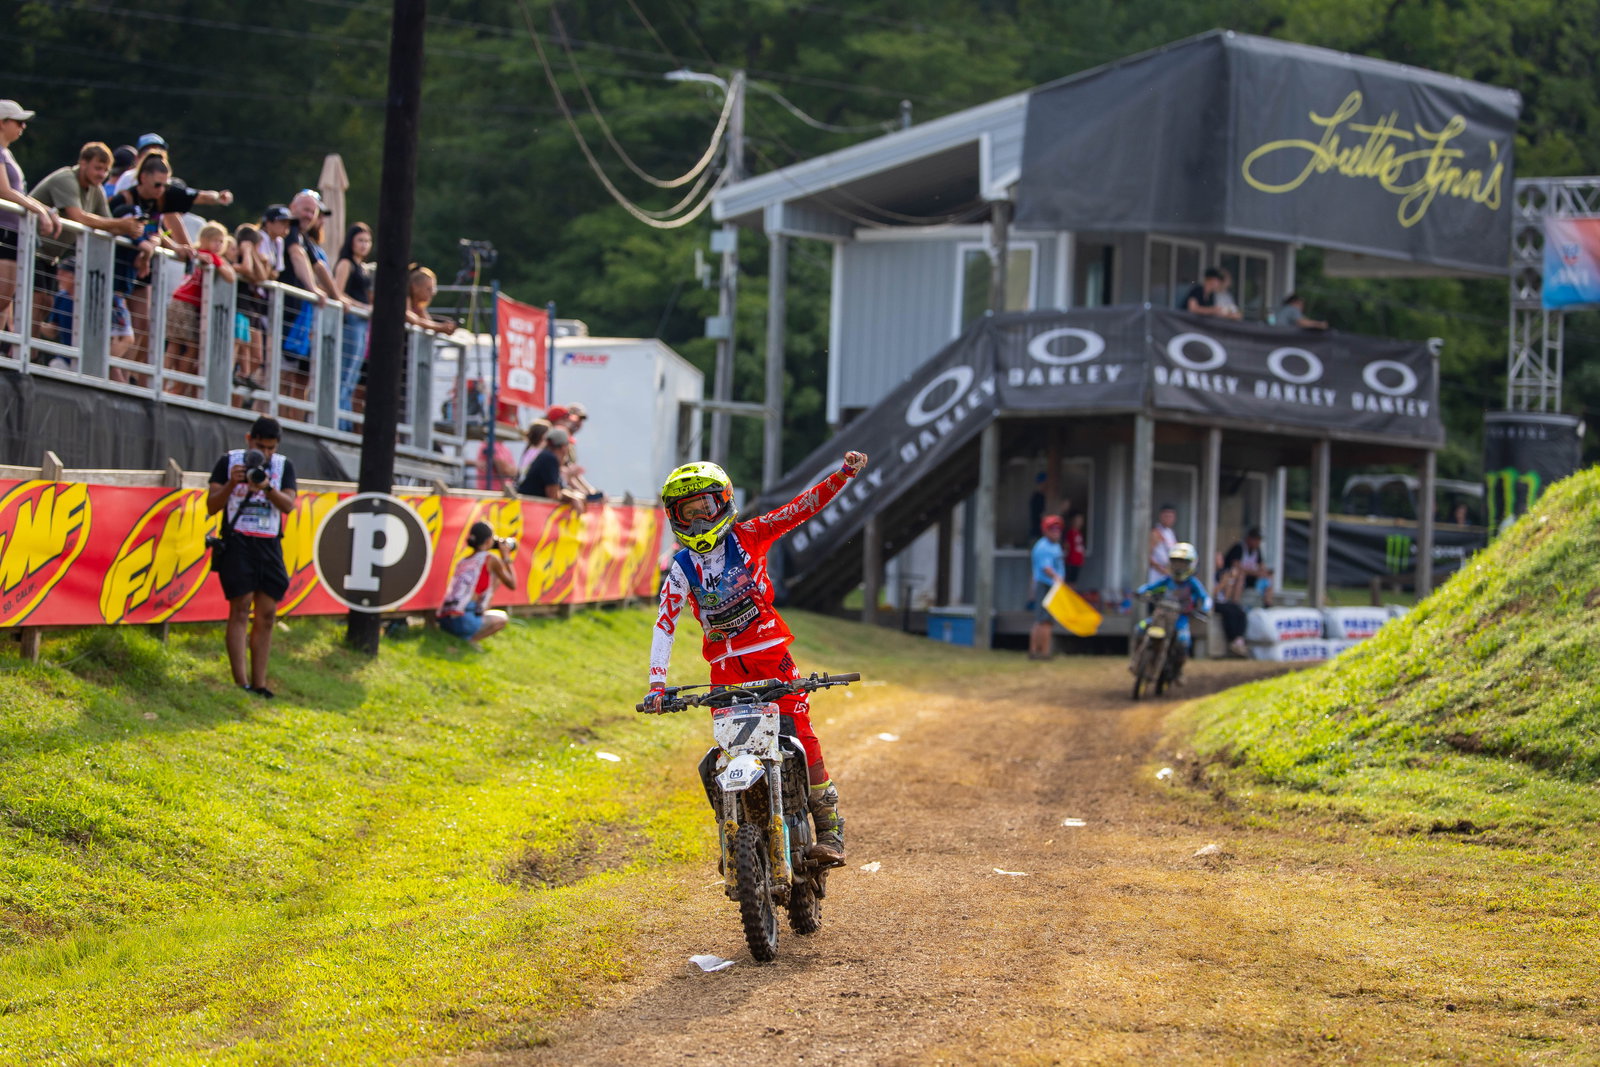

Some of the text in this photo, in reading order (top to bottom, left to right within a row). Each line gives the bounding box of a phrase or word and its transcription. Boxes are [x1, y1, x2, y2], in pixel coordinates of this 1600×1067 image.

[1008, 363, 1123, 387] OAKLEY
[1153, 364, 1239, 395] OAKLEY
[1254, 379, 1337, 408] OAKLEY
[1351, 391, 1430, 418] OAKLEY
[900, 375, 997, 464] OAKLEY
[791, 467, 884, 552] OAKLEY
[1276, 618, 1319, 630] PARTS
[1283, 646, 1327, 658] PARTS
[730, 716, 761, 749] 7
